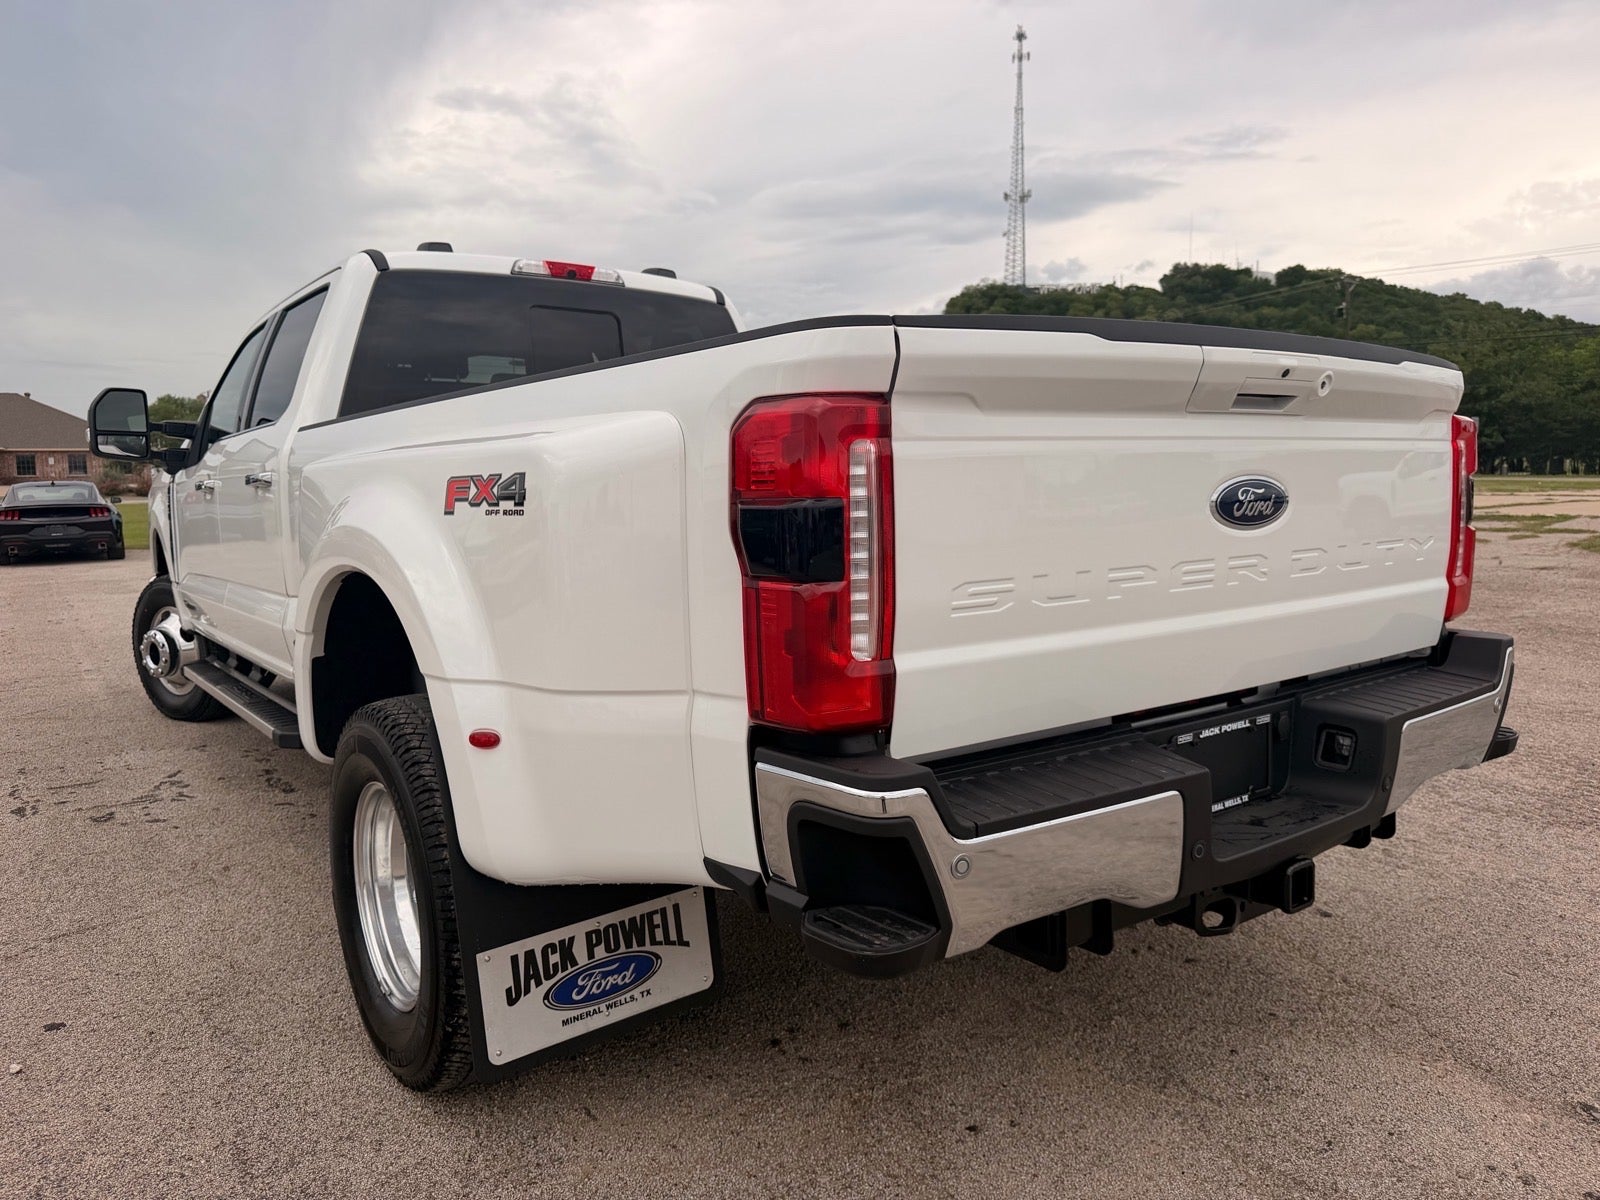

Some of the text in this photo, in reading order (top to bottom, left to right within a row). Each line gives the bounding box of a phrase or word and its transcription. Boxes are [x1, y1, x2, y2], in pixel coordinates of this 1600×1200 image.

[444, 472, 526, 515] FX4
[1233, 487, 1275, 517] Ford
[951, 535, 1435, 617] SUPER DUTY
[1199, 726, 1220, 739] JACK
[1221, 719, 1251, 734] POWELL
[1211, 802, 1224, 813] ERAL
[1241, 794, 1249, 803] TX
[505, 903, 691, 1007] JACK POWELL
[571, 962, 637, 1001] Ford
[561, 988, 652, 1027] MINERAL WELLS, TX
